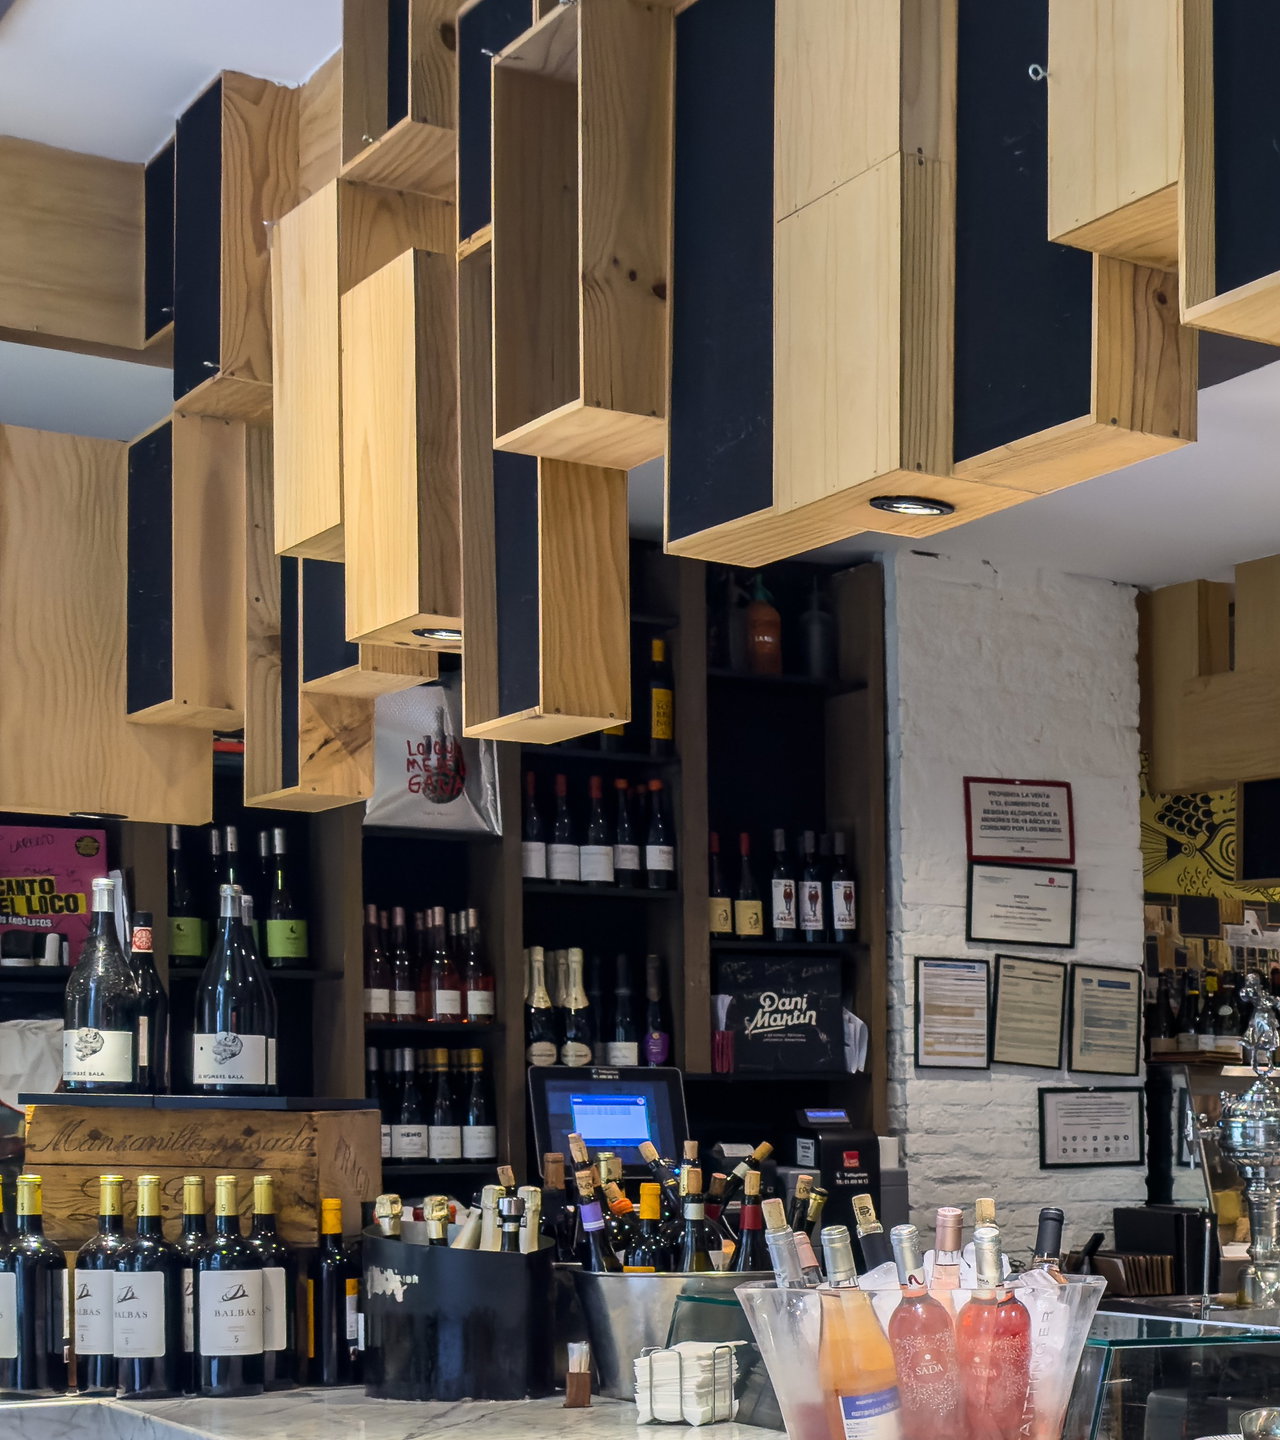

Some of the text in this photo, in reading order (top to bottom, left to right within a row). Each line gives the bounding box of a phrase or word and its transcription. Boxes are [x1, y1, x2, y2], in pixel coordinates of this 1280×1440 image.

[25, 894, 80, 914] LOCO
[760, 991, 808, 1012] Dani
[915, 1363, 944, 1376] SADA
